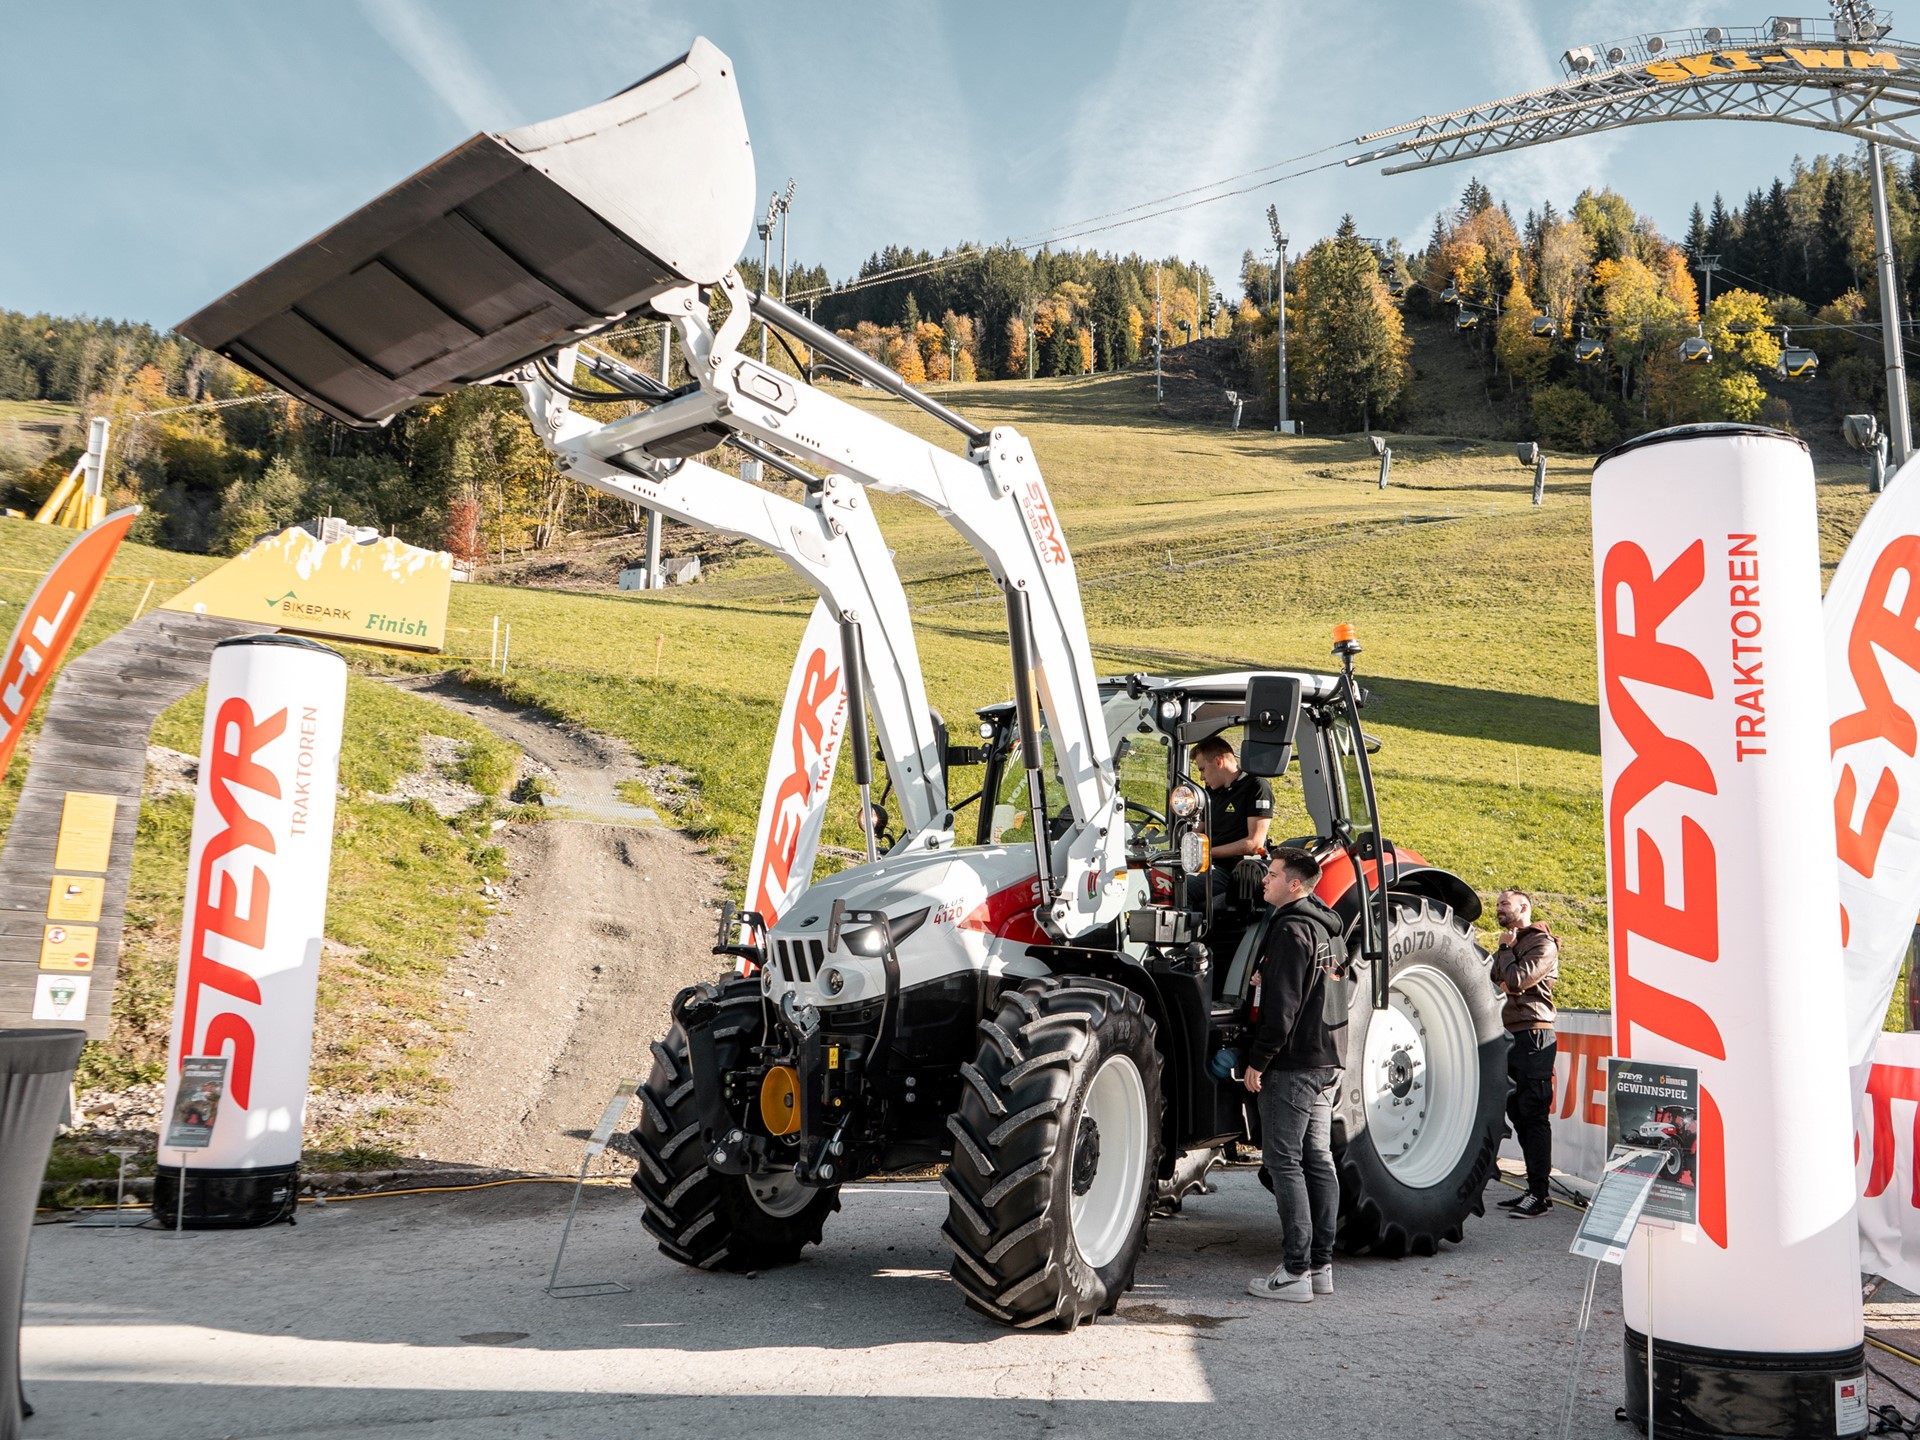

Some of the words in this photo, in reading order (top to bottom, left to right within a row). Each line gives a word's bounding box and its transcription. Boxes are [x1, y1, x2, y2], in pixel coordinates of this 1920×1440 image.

[1646, 48, 1899, 83] SKI-WM
[1023, 497, 1052, 564] S3920U
[1026, 481, 1066, 566] STEYR
[282, 601, 352, 621] BIKEPARK
[365, 613, 428, 637] Finish
[1727, 533, 1767, 763] TRAKTOREN
[291, 706, 318, 838] TRAKTOREN
[934, 906, 963, 925] 4120
[937, 897, 964, 912] PLUS
[1617, 1071, 1643, 1081] STEYR
[1617, 1082, 1688, 1100] GEWINNSPIEL
